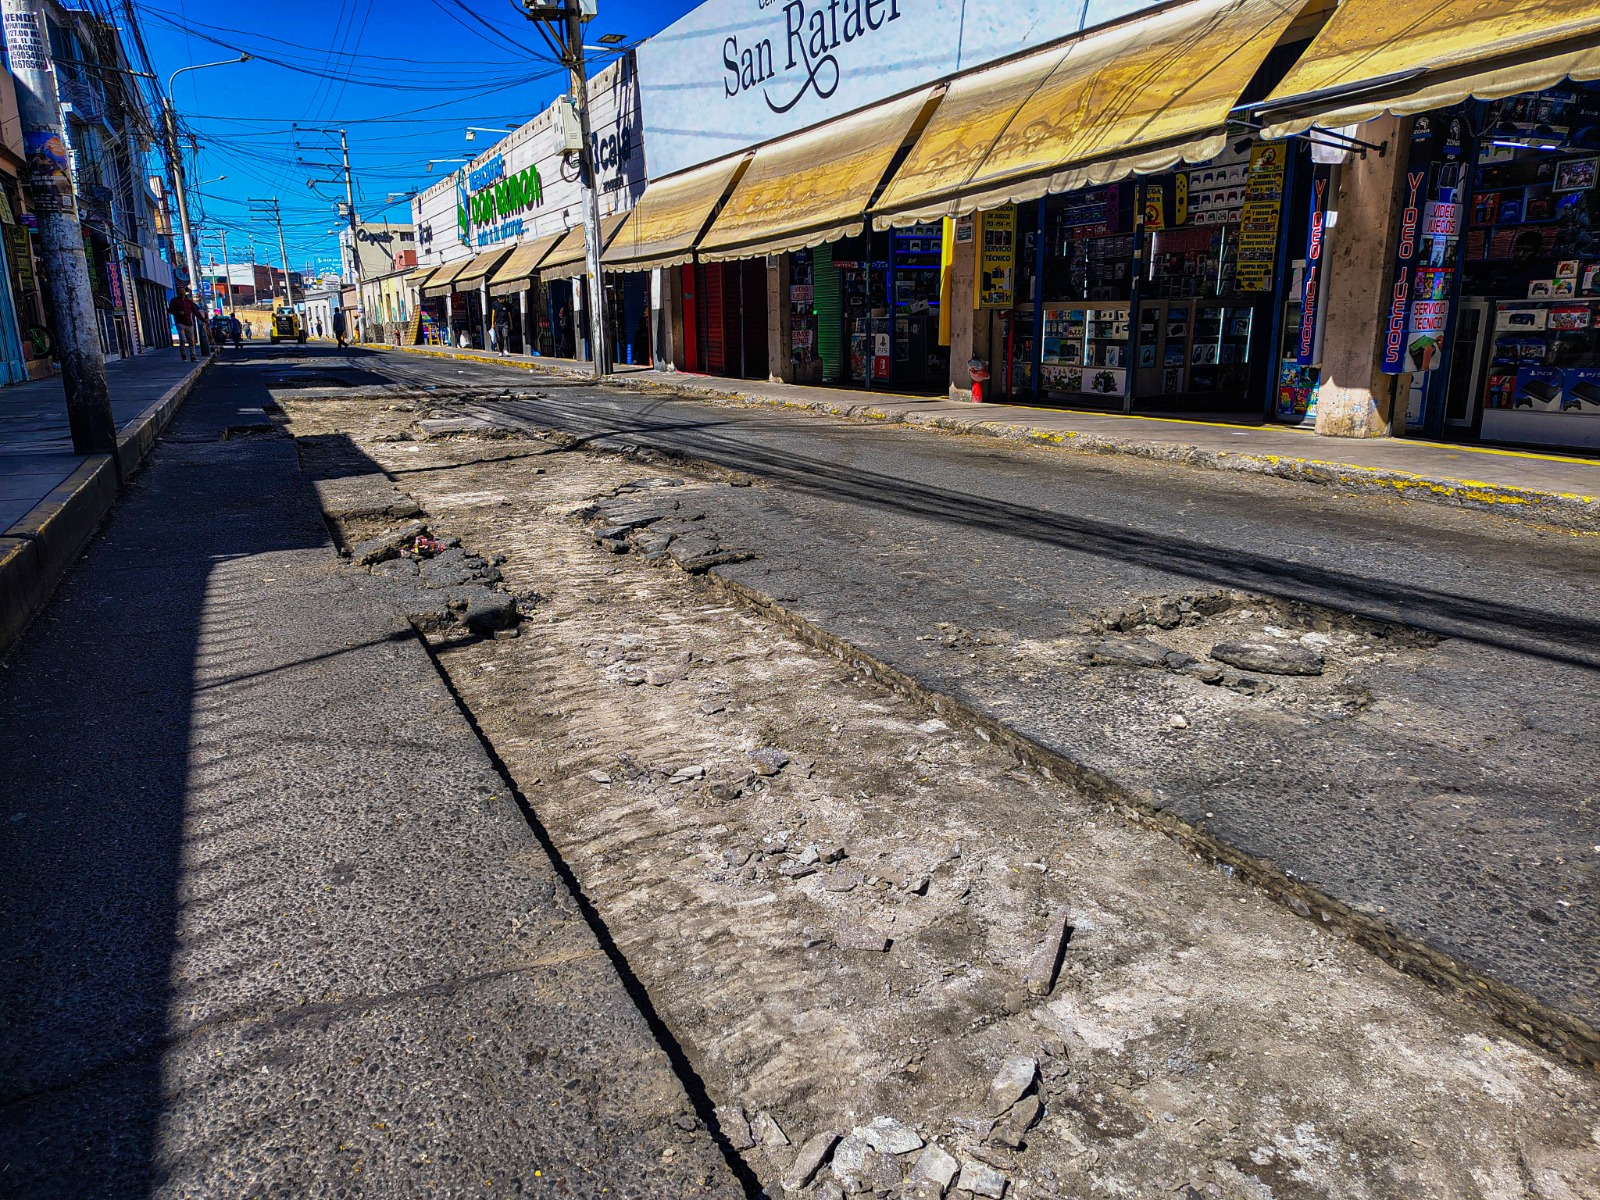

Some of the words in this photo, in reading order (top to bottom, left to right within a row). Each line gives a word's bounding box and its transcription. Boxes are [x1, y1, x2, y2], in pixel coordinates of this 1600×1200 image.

[723, 35, 775, 99] San
[1309, 179, 1327, 260] VIDEO
[1399, 172, 1424, 259] VIDEO
[1426, 220, 1456, 234] JUEGOS
[1433, 204, 1456, 219] VIDEO
[984, 245, 1012, 253] SERVICIO
[1300, 266, 1317, 356] JUEGOS
[1386, 267, 1408, 362] JUEGOS
[1413, 302, 1446, 316] SERVICIO
[1414, 317, 1443, 330] TECNICO
